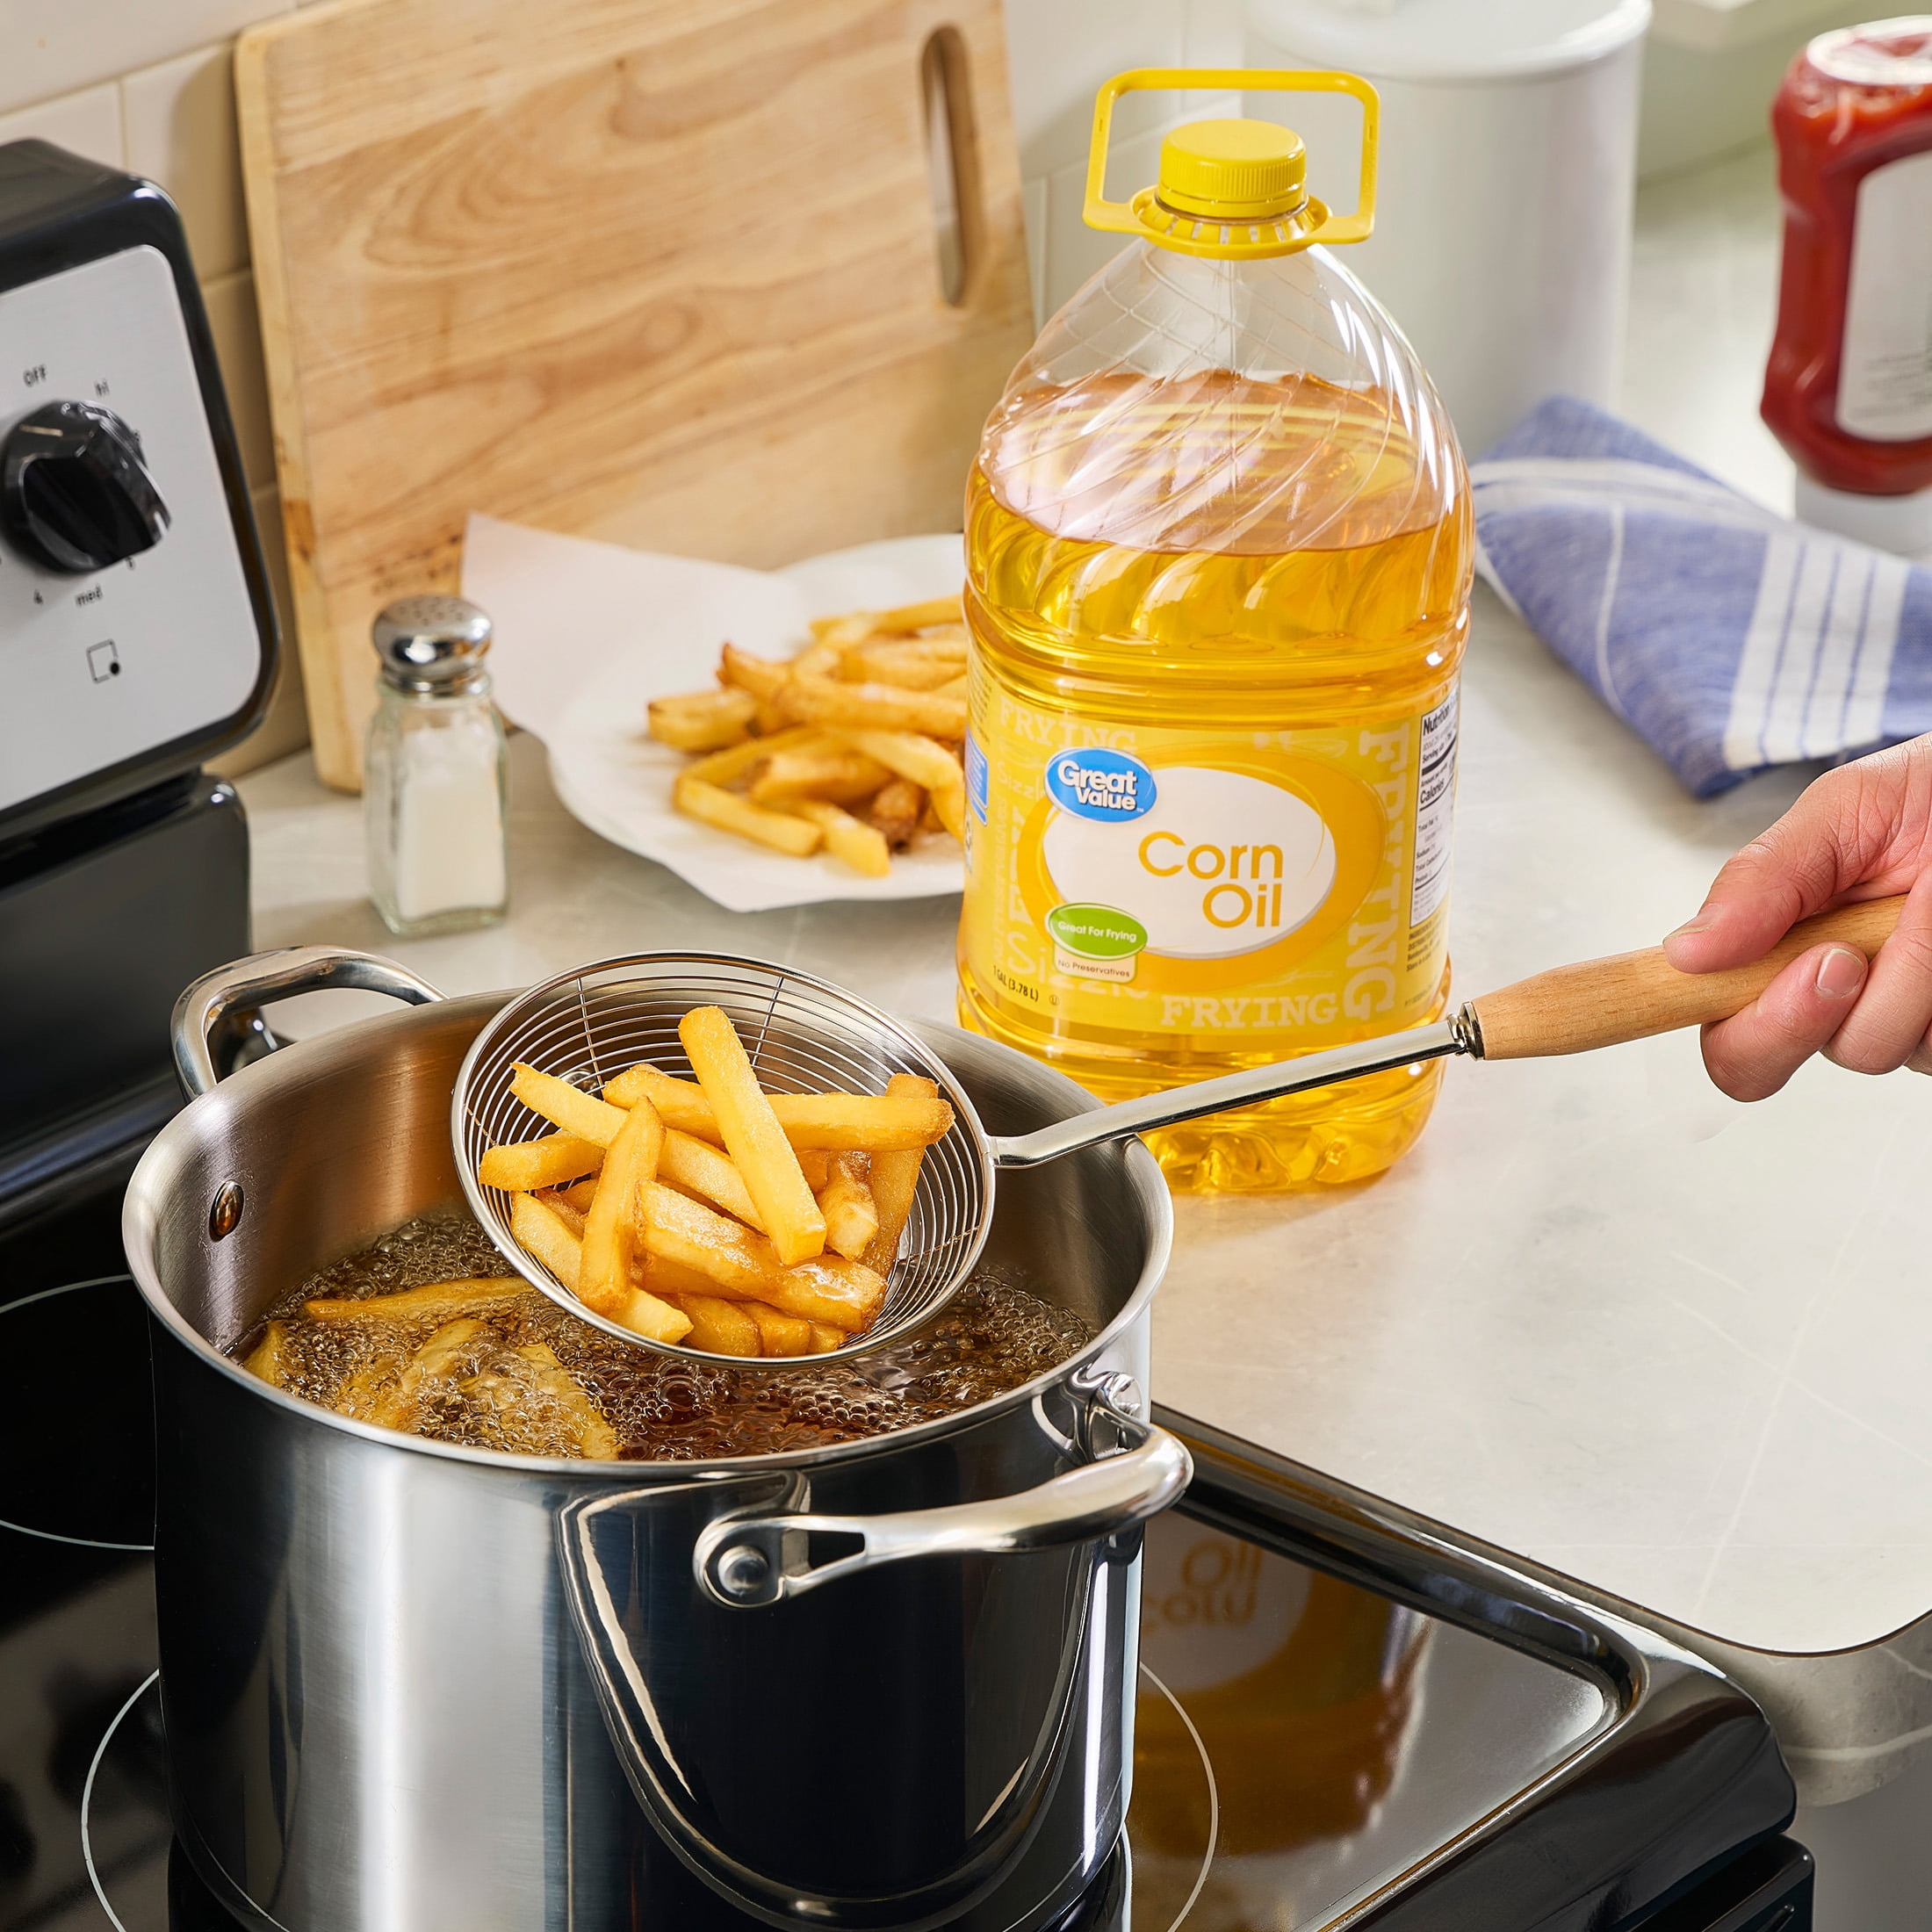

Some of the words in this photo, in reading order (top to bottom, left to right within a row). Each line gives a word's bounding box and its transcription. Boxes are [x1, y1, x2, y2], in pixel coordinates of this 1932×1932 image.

[76, 583, 104, 607] med
[999, 696, 1138, 753] FRYING
[1057, 760, 1138, 796] Great
[1076, 786, 1137, 811] Value
[1138, 831, 1284, 880] Corn
[1202, 883, 1282, 929] Oil
[1057, 920, 1086, 935] Great
[1088, 926, 1105, 938] For
[1106, 928, 1138, 944] Frying
[1058, 958, 1071, 970] No
[1072, 962, 1131, 978] Preservatives
[997, 970, 1008, 987] GAL
[1008, 977, 1029, 998] (3.78
[1029, 988, 1040, 1003] L)
[1160, 992, 1338, 1030] FRYING
